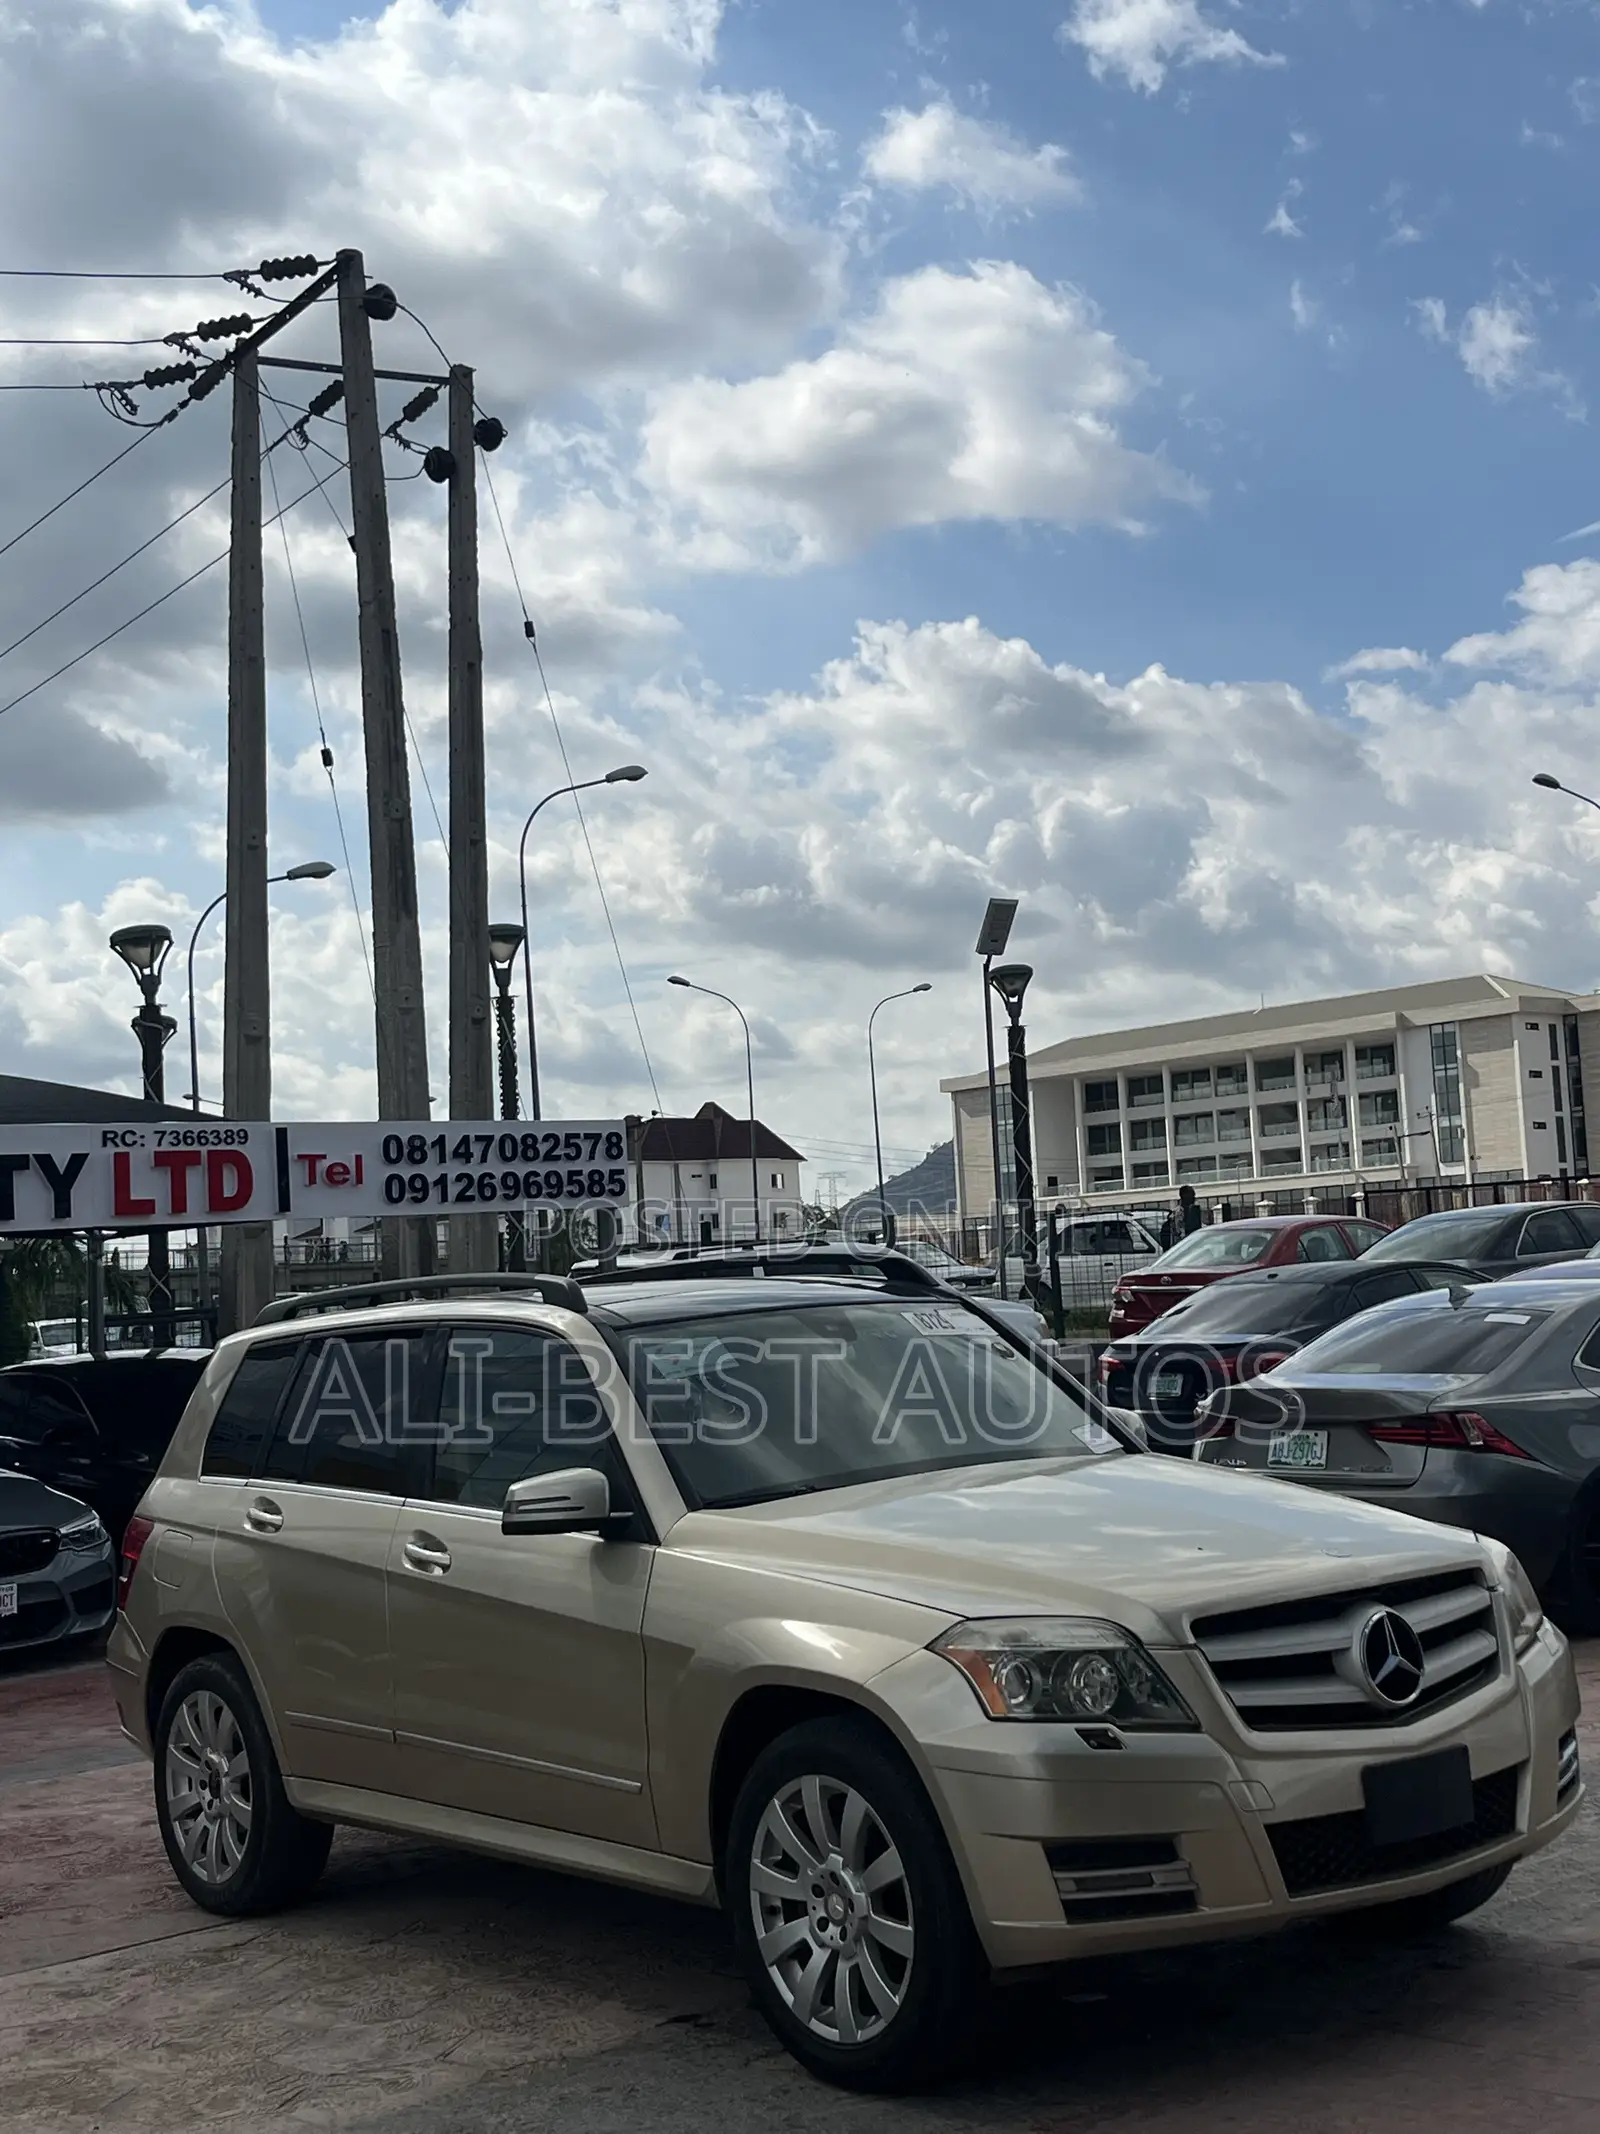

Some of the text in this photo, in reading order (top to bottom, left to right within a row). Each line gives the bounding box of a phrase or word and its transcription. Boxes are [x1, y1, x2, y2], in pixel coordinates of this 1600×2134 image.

[101, 1128, 249, 1148] RC: 7366389
[381, 1131, 624, 1166] 08147082578
[113, 1150, 254, 1216] LTD
[296, 1153, 364, 1187] Tel
[383, 1168, 627, 1204] 09126969585
